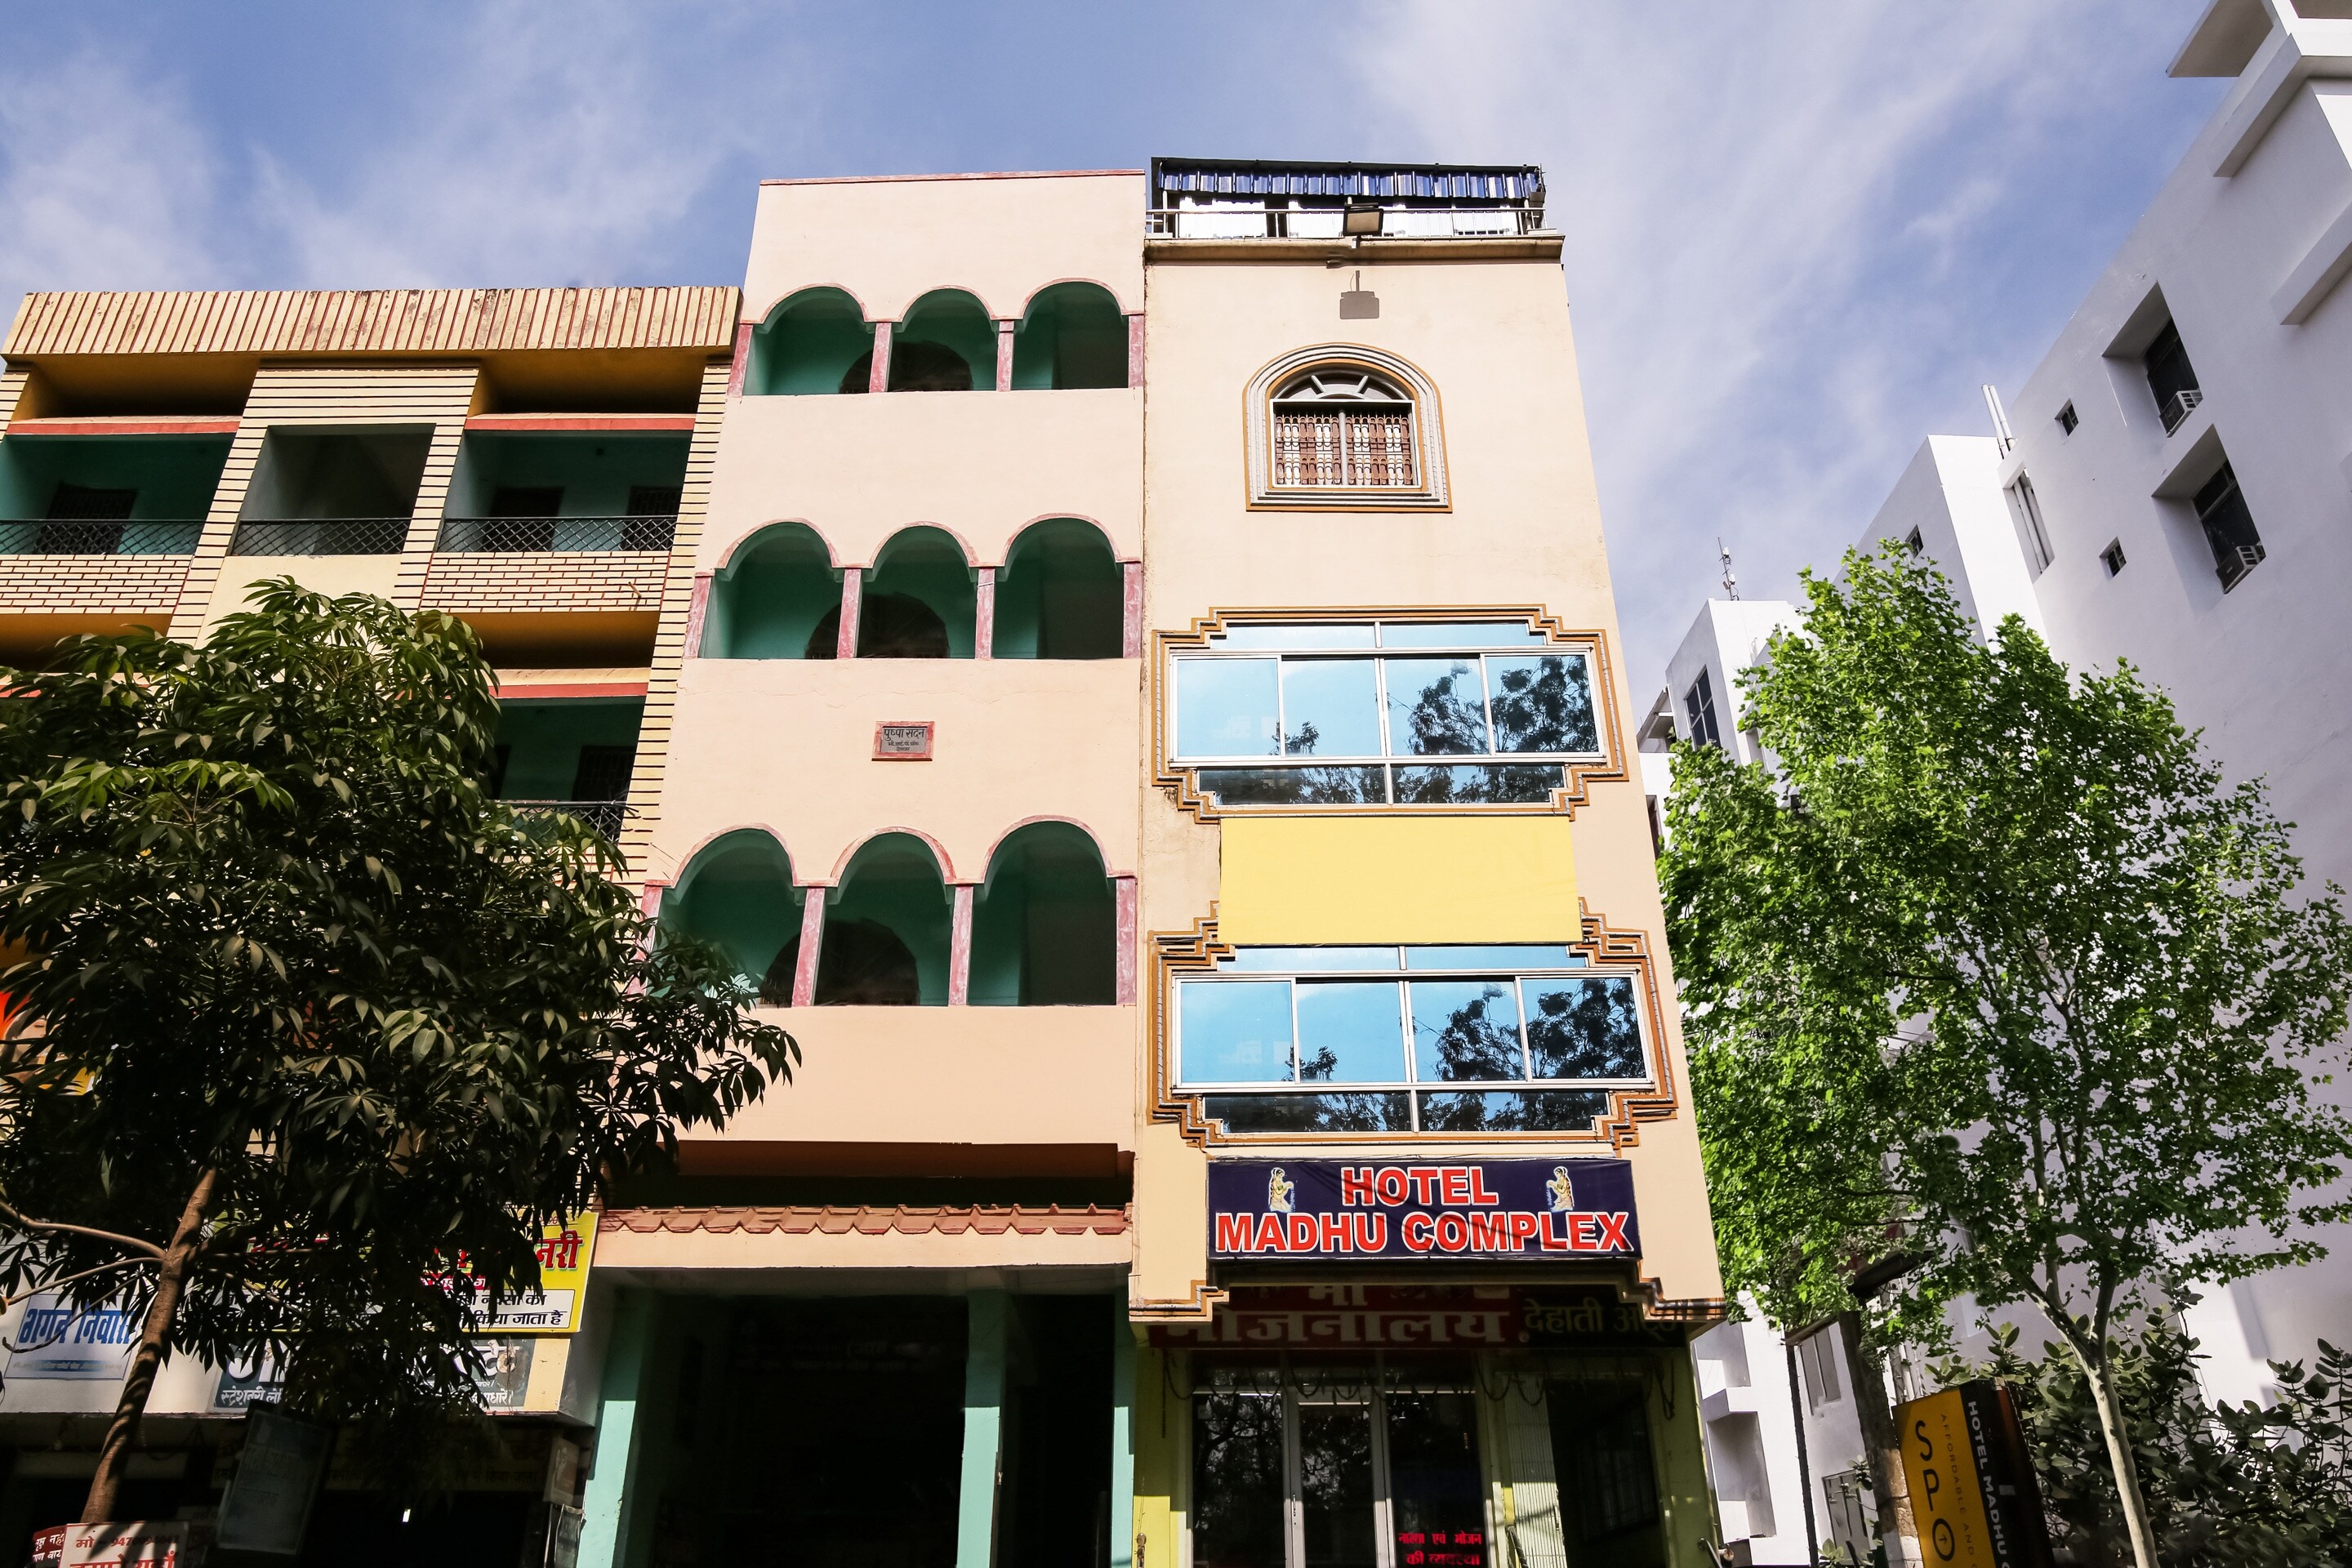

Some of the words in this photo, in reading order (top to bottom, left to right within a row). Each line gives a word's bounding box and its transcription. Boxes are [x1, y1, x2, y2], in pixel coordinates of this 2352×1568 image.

[1342, 1166, 1499, 1206] HOTEL
[1216, 1212, 1386, 1253] MADHU
[1402, 1211, 1634, 1252] COMPLEX
[512, 1312, 548, 1325] जाता
[550, 1310, 564, 1325] है
[1523, 1297, 1605, 1333] देहाती
[1940, 1414, 1966, 1514] AFFORDABLE
[1962, 1523, 1975, 1556] AND
[1967, 1401, 1989, 1469] HOTEL
[1983, 1475, 2007, 1555] MADHU
[1432, 1530, 1446, 1544] एवं
[1454, 1529, 1483, 1545] भोजन
[1405, 1549, 1425, 1566] की
